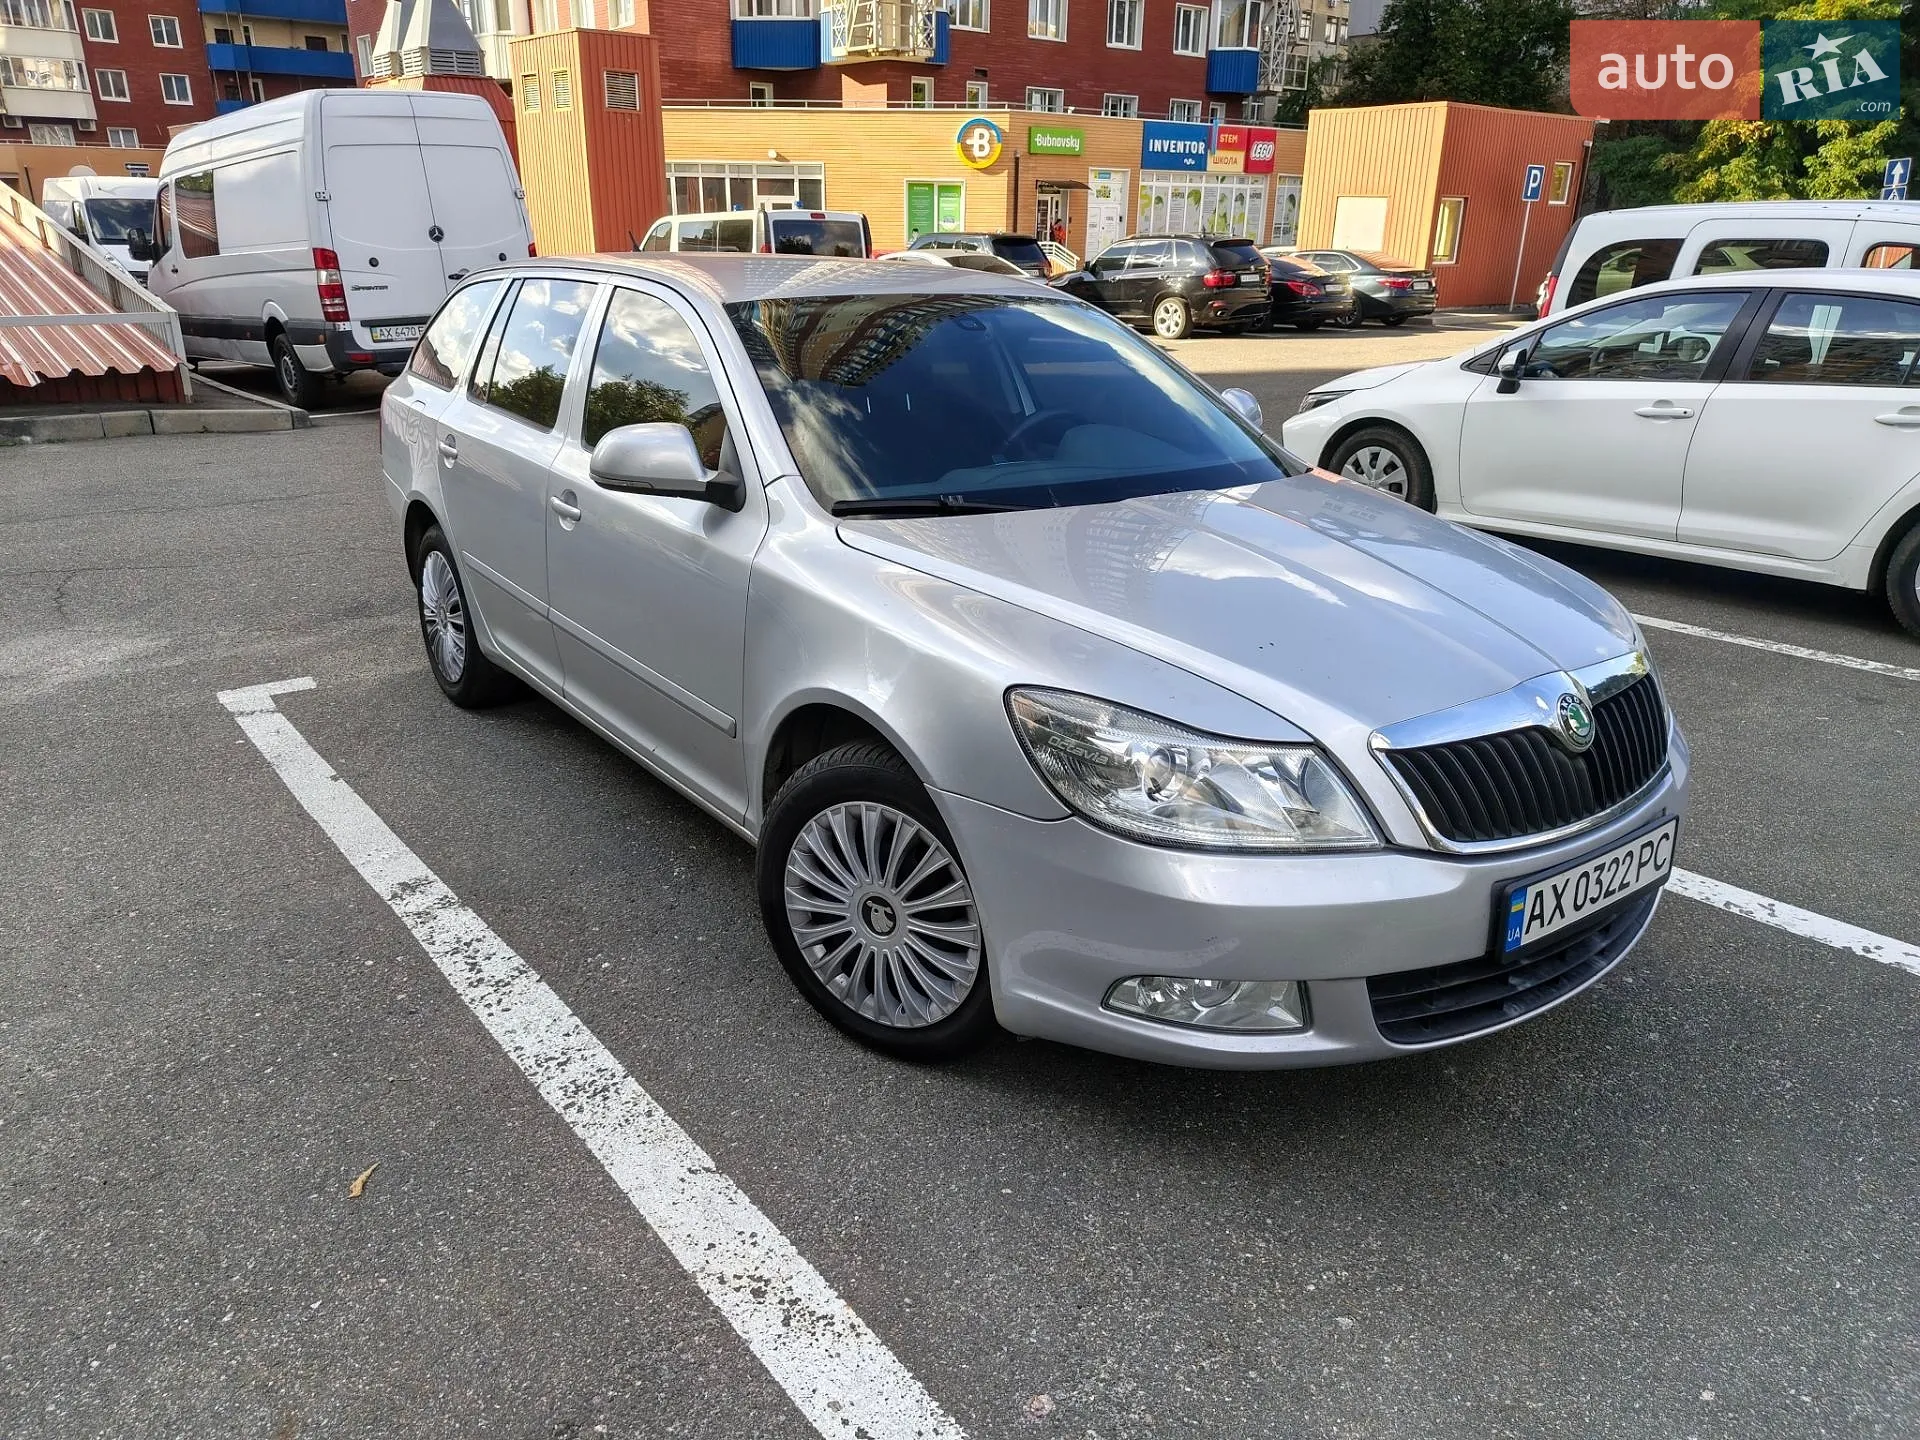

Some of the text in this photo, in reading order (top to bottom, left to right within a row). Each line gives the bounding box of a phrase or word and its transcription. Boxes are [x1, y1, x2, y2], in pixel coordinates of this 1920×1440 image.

[1035, 133, 1080, 151] Bubnovsky
[1149, 139, 1205, 155] INVENTOR
[1219, 133, 1238, 144] STEM
[1250, 141, 1275, 161] LEGO
[1212, 156, 1238, 165] ШКОЛА
[1528, 169, 1541, 191] P
[379, 327, 393, 338] AX
[395, 326, 416, 337] 6470
[1048, 735, 1110, 765] Octavia
[1507, 926, 1520, 943] UA
